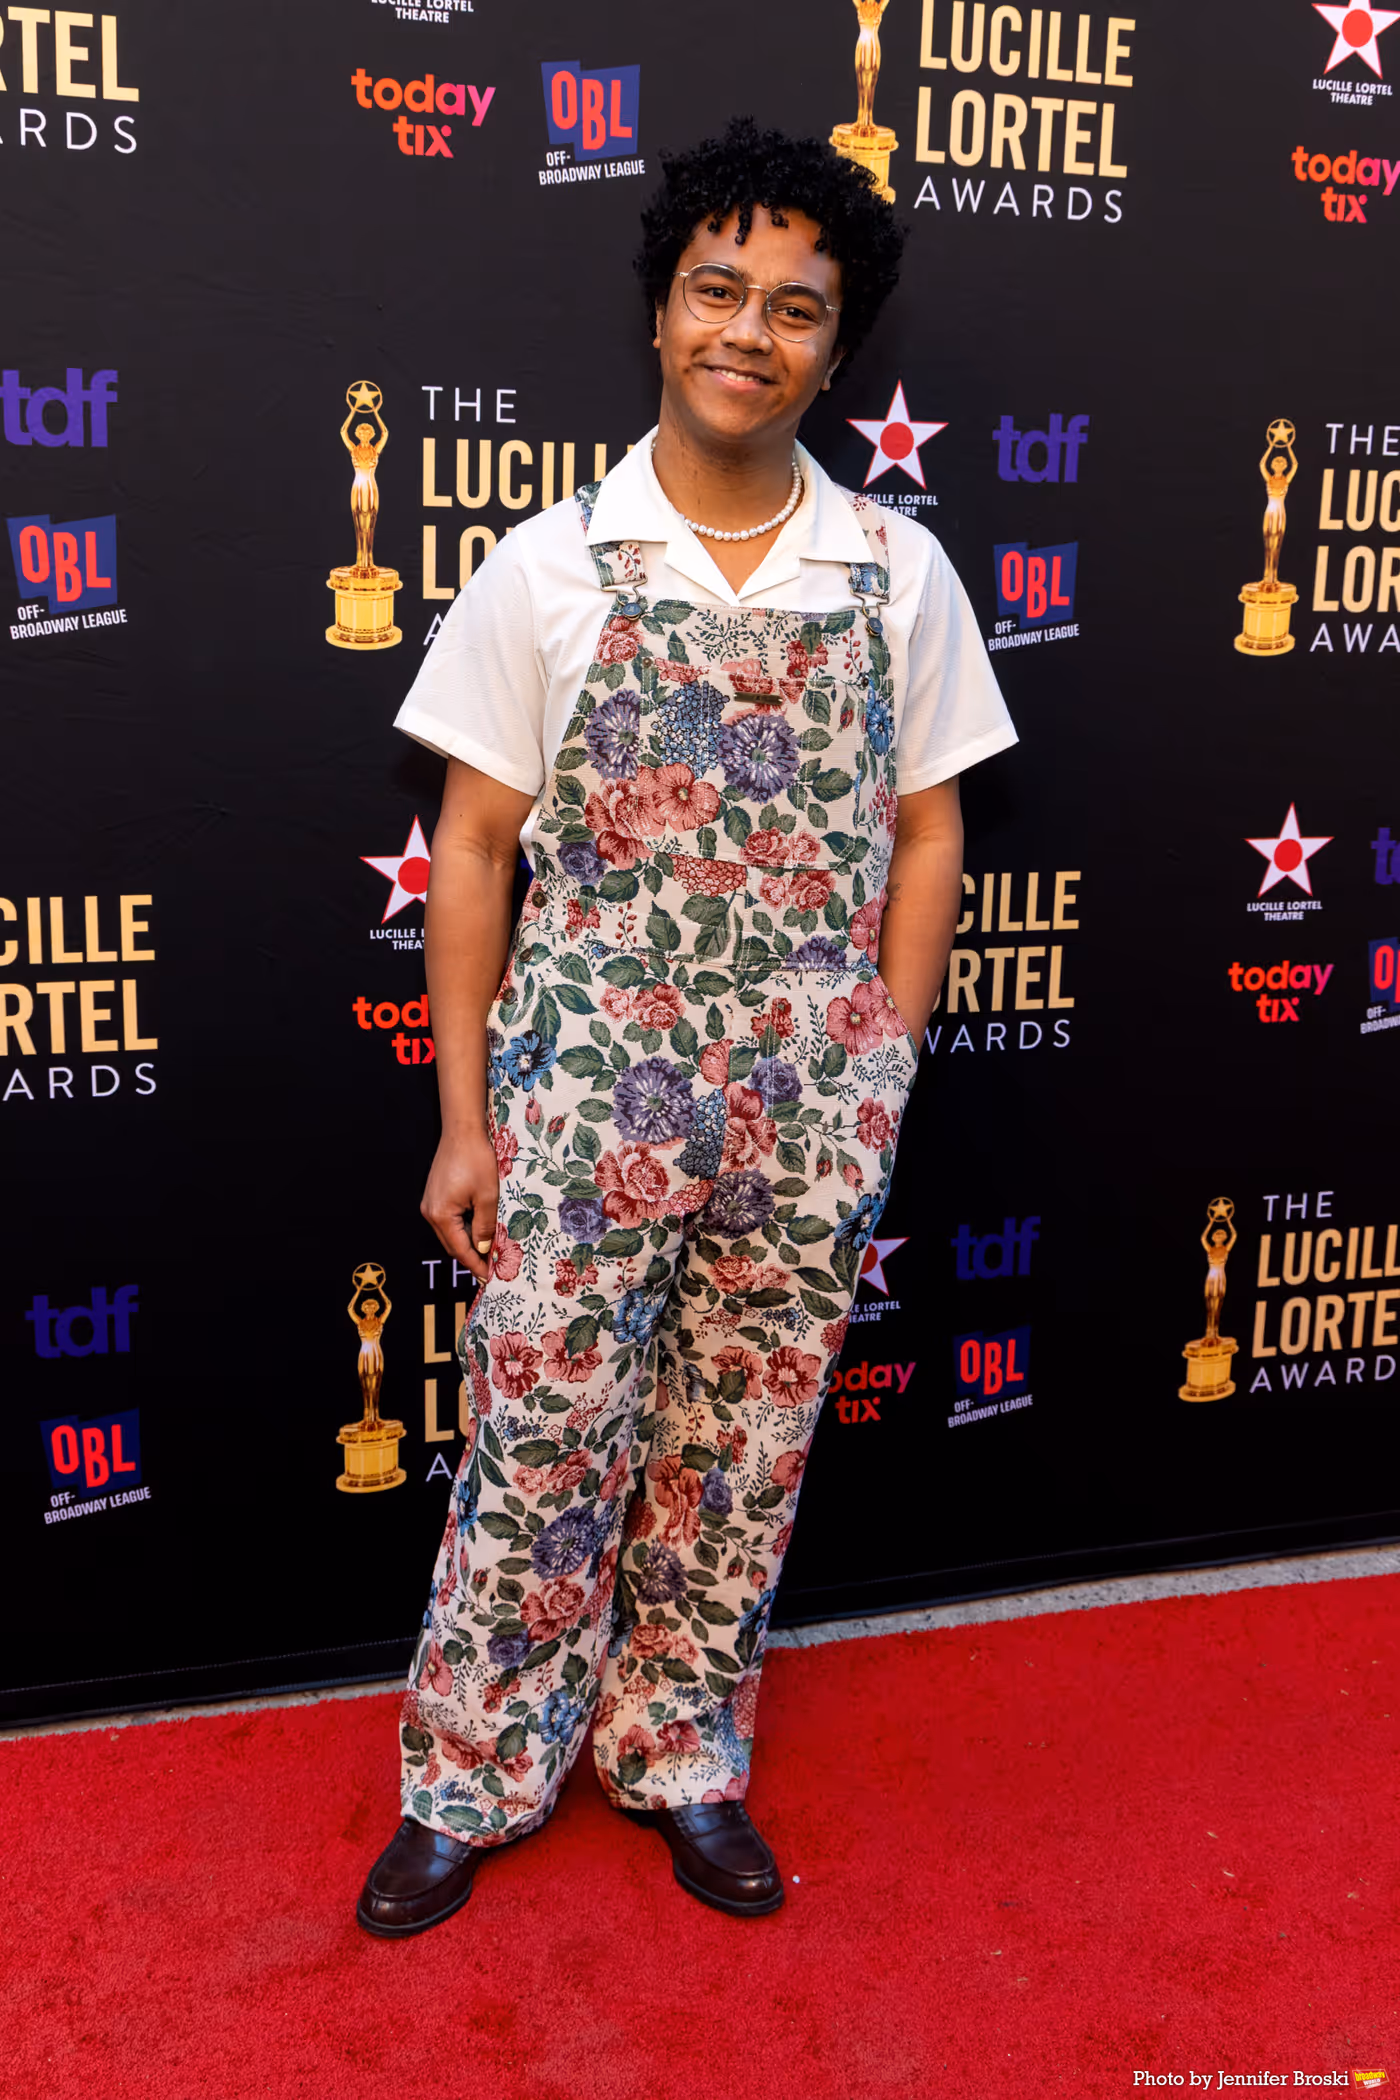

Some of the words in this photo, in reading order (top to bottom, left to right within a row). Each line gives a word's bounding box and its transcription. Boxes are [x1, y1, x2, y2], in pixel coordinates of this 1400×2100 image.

[395, 7, 450, 23] THEATRE
[426, 0, 474, 12] LORTEL
[0, 6, 140, 102] TEL
[920, 0, 1136, 87] LUCILLE
[351, 68, 496, 127] today
[1312, 79, 1352, 92] LUCILLE
[1355, 82, 1393, 96] LORTEL
[1330, 92, 1373, 106] THEATRE
[551, 70, 633, 150] OBL
[0, 108, 137, 154] RDS
[393, 115, 454, 158] tix
[915, 86, 1128, 179] LORTEL
[538, 164, 602, 186] BROADWAY
[604, 159, 645, 179] LEAGUE
[546, 151, 571, 167] OFF-
[1291, 145, 1400, 196] today
[914, 175, 1122, 223] AWARDS
[1320, 186, 1368, 224] tix
[0, 368, 118, 448] tdf
[421, 386, 517, 423] THE
[992, 413, 1090, 483] tdf
[1325, 423, 1400, 456] THE
[898, 495, 939, 506] LORTEL
[1319, 468, 1400, 532] LUC
[19, 525, 112, 602] OBL
[1001, 551, 1070, 618] OBL
[10, 616, 80, 640] BROADWAY
[82, 609, 128, 629] LEAGUE
[17, 604, 46, 621] OFF-
[995, 620, 1016, 635] OFF-
[988, 630, 1042, 652] BROADWAY
[1044, 624, 1080, 642] LEAGUE
[1309, 622, 1400, 653] AWA
[1246, 902, 1284, 912] LUCILLE
[1287, 900, 1323, 910] LORTEL
[1264, 911, 1304, 921] THEATRE
[370, 928, 416, 939] LUCILLE
[392, 940, 425, 950] THEA
[932, 945, 1075, 1014] RTEL
[1227, 960, 1334, 996] today
[1256, 993, 1300, 1023] tix
[3, 1063, 156, 1101] ARDS
[1263, 1191, 1334, 1222] THE
[950, 1216, 1041, 1280] tdf
[1257, 1224, 1400, 1288] LUCILL
[24, 1284, 139, 1358] tdf
[864, 1300, 901, 1312] LORTEL
[1252, 1288, 1400, 1358] LORTE
[960, 1338, 1024, 1395] OBL
[1250, 1355, 1397, 1393] AWARD
[835, 1396, 881, 1424] tix
[947, 1404, 998, 1428] BROADWAY
[1000, 1394, 1033, 1414] LEAGUE
[954, 1398, 974, 1413] OFF-
[51, 1424, 136, 1488] OBL
[44, 1497, 107, 1525] BROADWAY
[109, 1486, 151, 1509] LEAGUE
[50, 1491, 75, 1508] OFF-
